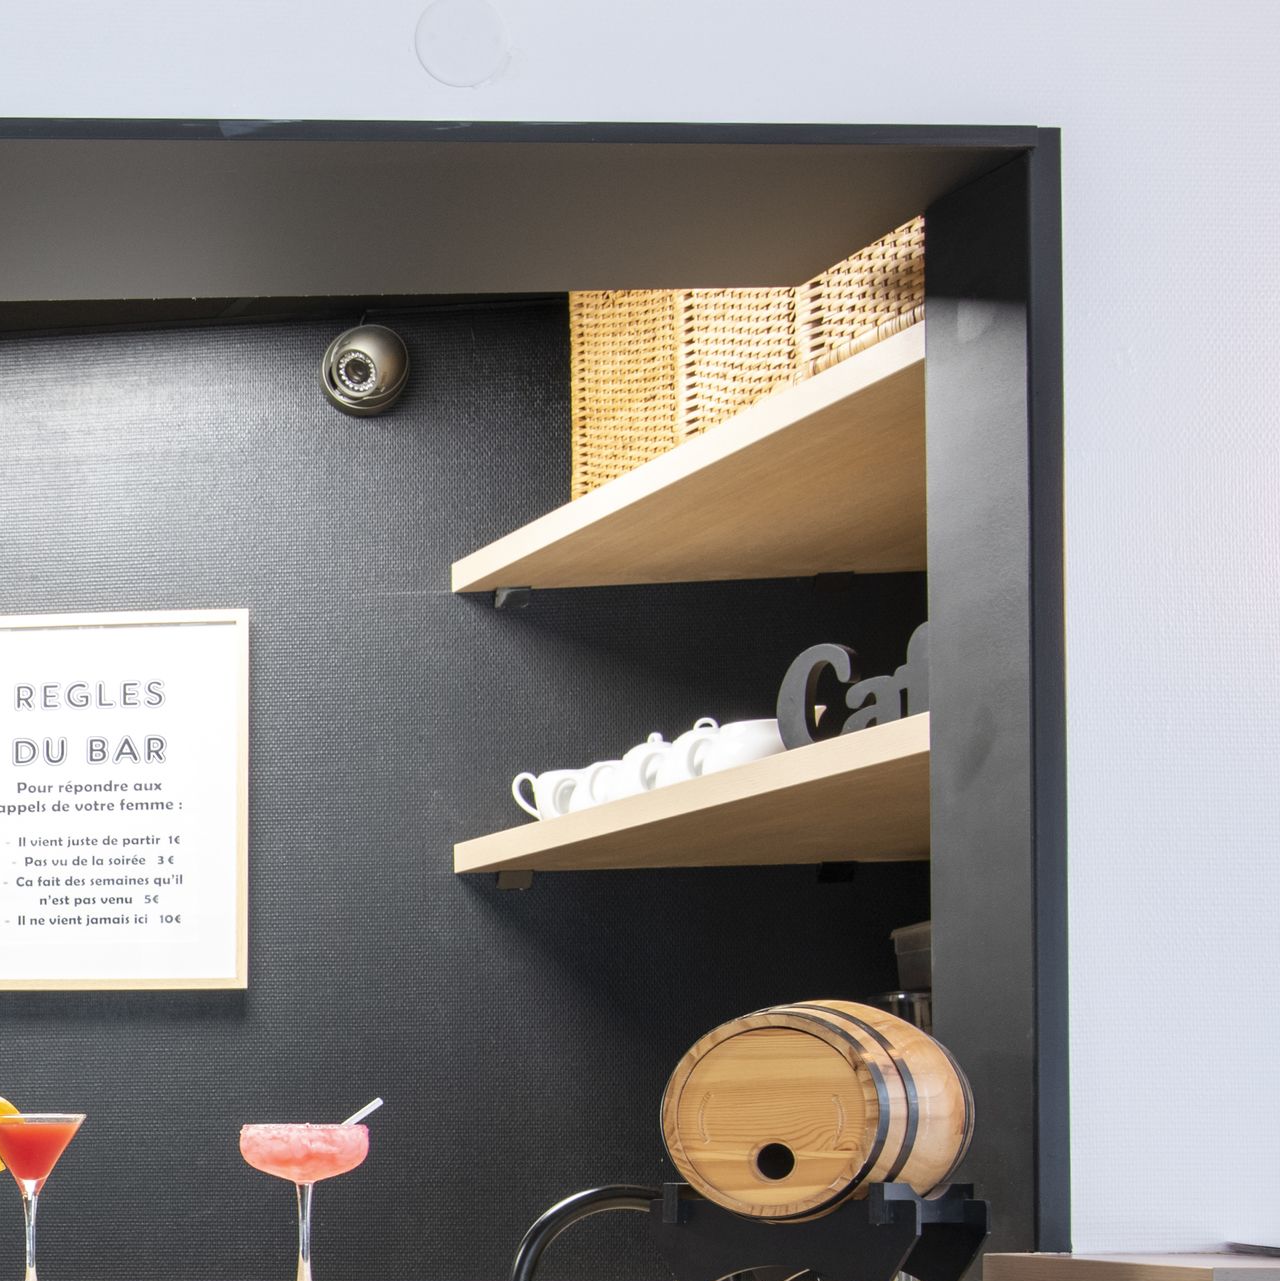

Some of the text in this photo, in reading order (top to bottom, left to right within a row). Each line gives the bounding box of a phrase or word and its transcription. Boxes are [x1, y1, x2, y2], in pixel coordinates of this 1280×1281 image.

[15, 680, 165, 710] REGLES
[13, 735, 168, 766] DU BAR
[16, 780, 162, 796] Pour répondre aux
[51, 799, 70, 813] de
[74, 800, 115, 812] votre
[119, 798, 174, 811] femme
[30, 836, 64, 847] vient
[66, 835, 99, 848] juste
[102, 835, 119, 847] de
[122, 834, 161, 848] partir
[24, 856, 48, 867] Pas
[51, 858, 68, 867] vu
[71, 855, 88, 867] de
[91, 855, 104, 866] la
[108, 854, 146, 866] soirée
[15, 876, 34, 888] Ca
[37, 875, 61, 887] fait
[64, 875, 86, 887] des
[90, 875, 150, 887] semaines
[74, 896, 97, 908] pas
[100, 896, 133, 905] venu
[29, 917, 46, 926] ne
[48, 914, 83, 926] vient
[85, 914, 130, 927] jamais
[134, 913, 148, 925] ici
[159, 914, 181, 924] 10€
